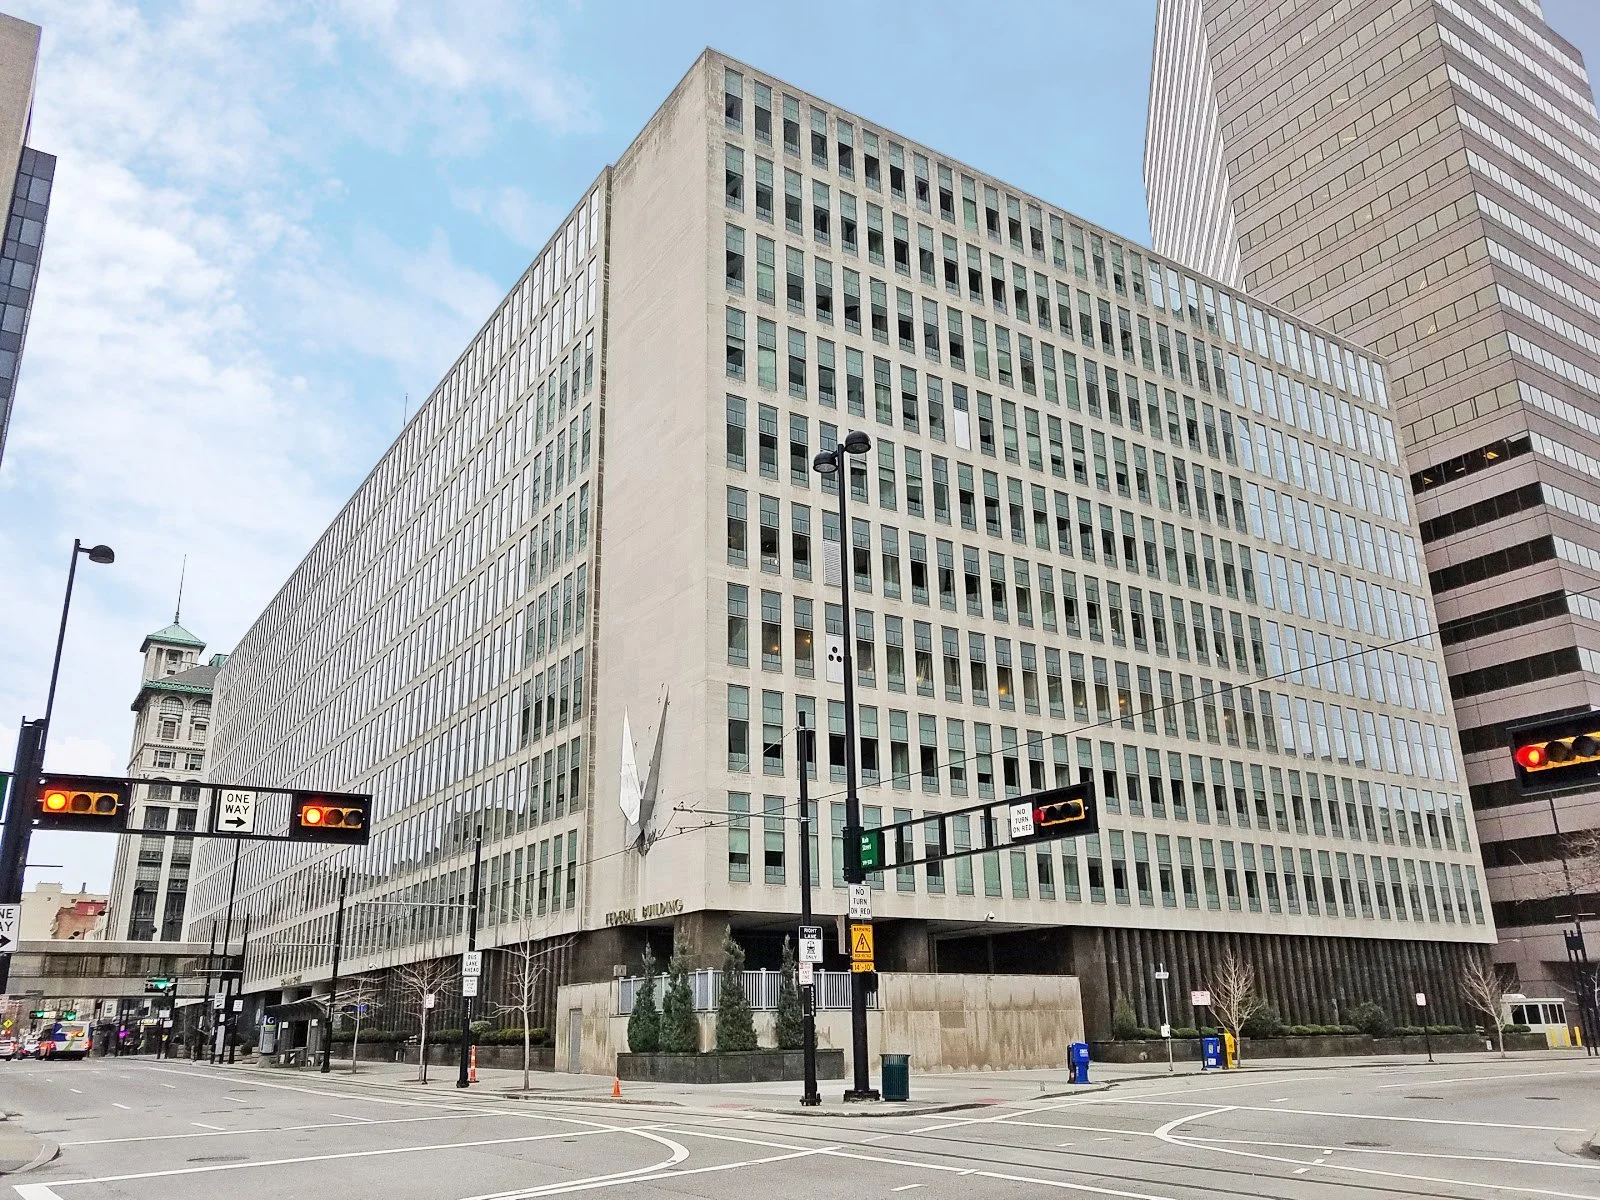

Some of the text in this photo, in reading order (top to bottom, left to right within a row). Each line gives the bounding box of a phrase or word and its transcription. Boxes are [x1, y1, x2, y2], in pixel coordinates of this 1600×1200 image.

[226, 793, 250, 803] ONE
[225, 804, 250, 815] WAY
[1016, 808, 1026, 816] NO
[1015, 816, 1029, 824] TURN
[1012, 824, 1032, 834] ON RED
[855, 888, 865, 896] NO
[853, 897, 868, 906] TURN
[0, 908, 14, 919] NE
[605, 898, 684, 926] FEDERAL BUILDING
[850, 907, 871, 915] ON RED
[0, 921, 14, 932] AY
